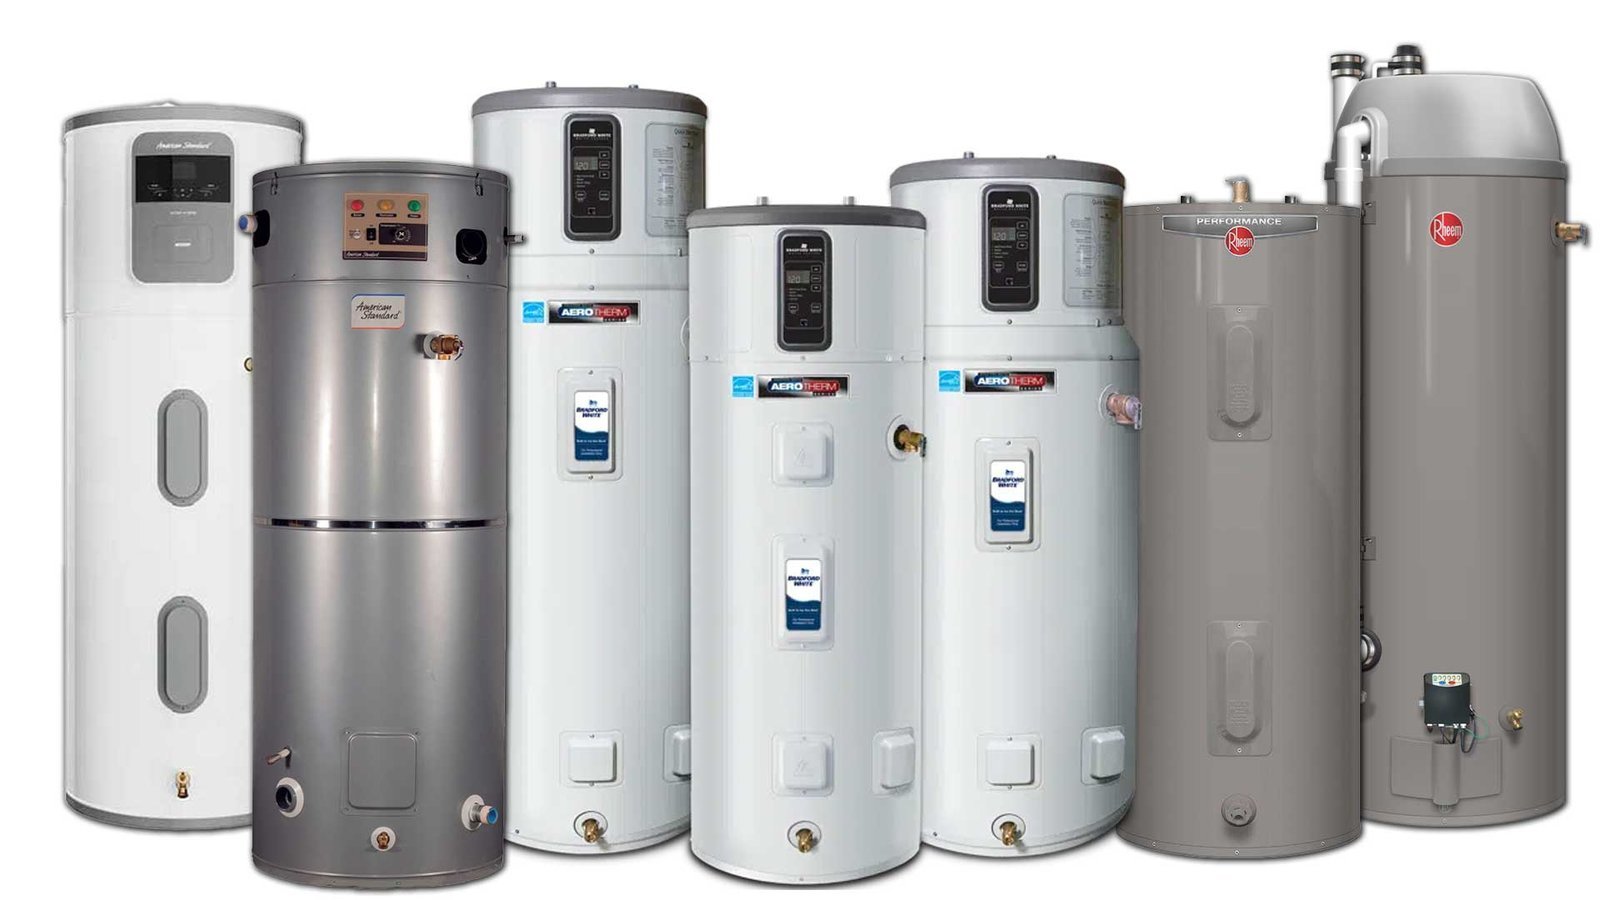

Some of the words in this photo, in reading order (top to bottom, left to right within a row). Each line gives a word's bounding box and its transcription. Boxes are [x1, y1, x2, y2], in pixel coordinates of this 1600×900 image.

[1196, 217, 1282, 225] PERFORMANCE
[1433, 212, 1462, 241] Rheem
[993, 232, 1007, 240] 120
[1228, 226, 1253, 252] Rheem
[355, 301, 392, 311] American
[360, 310, 401, 320] Standard
[561, 308, 628, 316] AEROTHERM
[977, 376, 1043, 385] AEROTHERM
[771, 382, 837, 390] AEROTHERM
